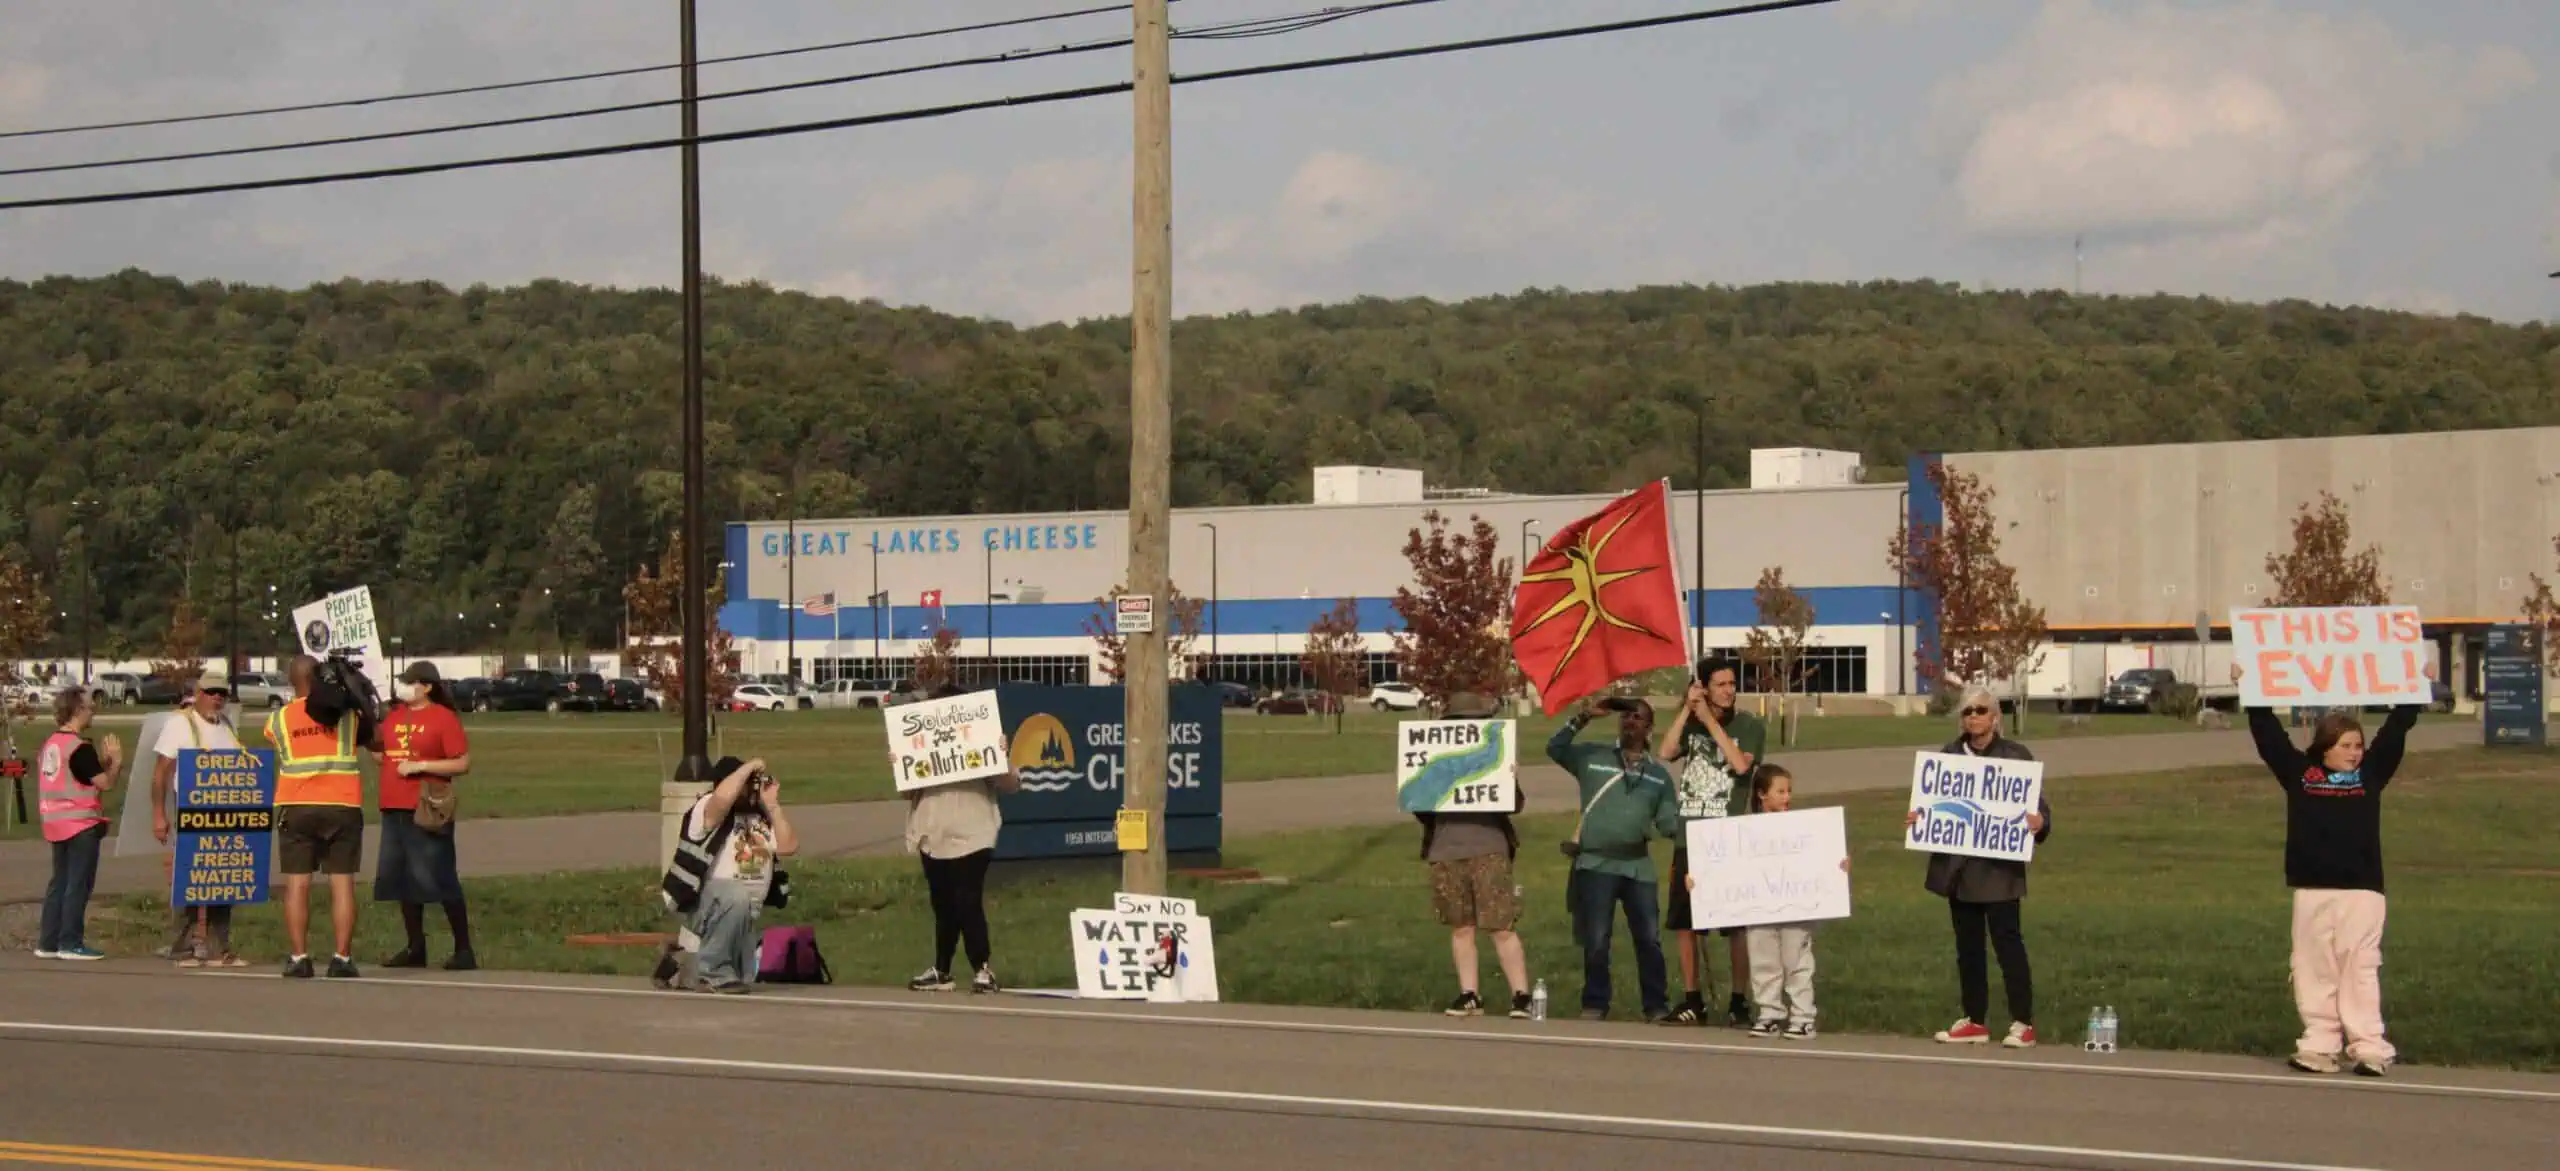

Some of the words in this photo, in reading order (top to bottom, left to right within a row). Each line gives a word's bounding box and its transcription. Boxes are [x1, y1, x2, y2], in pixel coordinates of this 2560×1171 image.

[762, 532, 851, 557] GREAT
[872, 528, 961, 554] LAKES
[983, 524, 1098, 552] CHEESE
[325, 590, 369, 620] PEOPLE
[332, 619, 374, 648] PLANET
[2239, 610, 2361, 647] THIS
[2376, 611, 2421, 643] IS
[2256, 648, 2419, 697] EVIL!
[1087, 723, 1125, 746] GRE
[1168, 722, 1202, 745] KES
[1408, 723, 1480, 746] WATER
[195, 754, 258, 770] GREAT
[1404, 750, 1428, 767] IS
[195, 772, 257, 787] LAKES
[1087, 753, 1201, 791] CHSE
[1921, 759, 1975, 798] Clean
[1981, 764, 2033, 804] River
[189, 790, 264, 805] CHEESE
[1454, 784, 1500, 805] LIFE
[180, 812, 270, 828] POLLUTES
[1912, 806, 1966, 847] Clean
[1972, 813, 2029, 853] Water
[200, 835, 249, 850] N.Y.S.
[193, 852, 254, 867] FRESH
[190, 869, 255, 884] WATER
[185, 885, 256, 901] SUPPLY
[1119, 896, 1151, 914] SAY
[1160, 900, 1186, 916] NO
[1083, 920, 1188, 944] WATER
[1100, 969, 1160, 991] LIF
